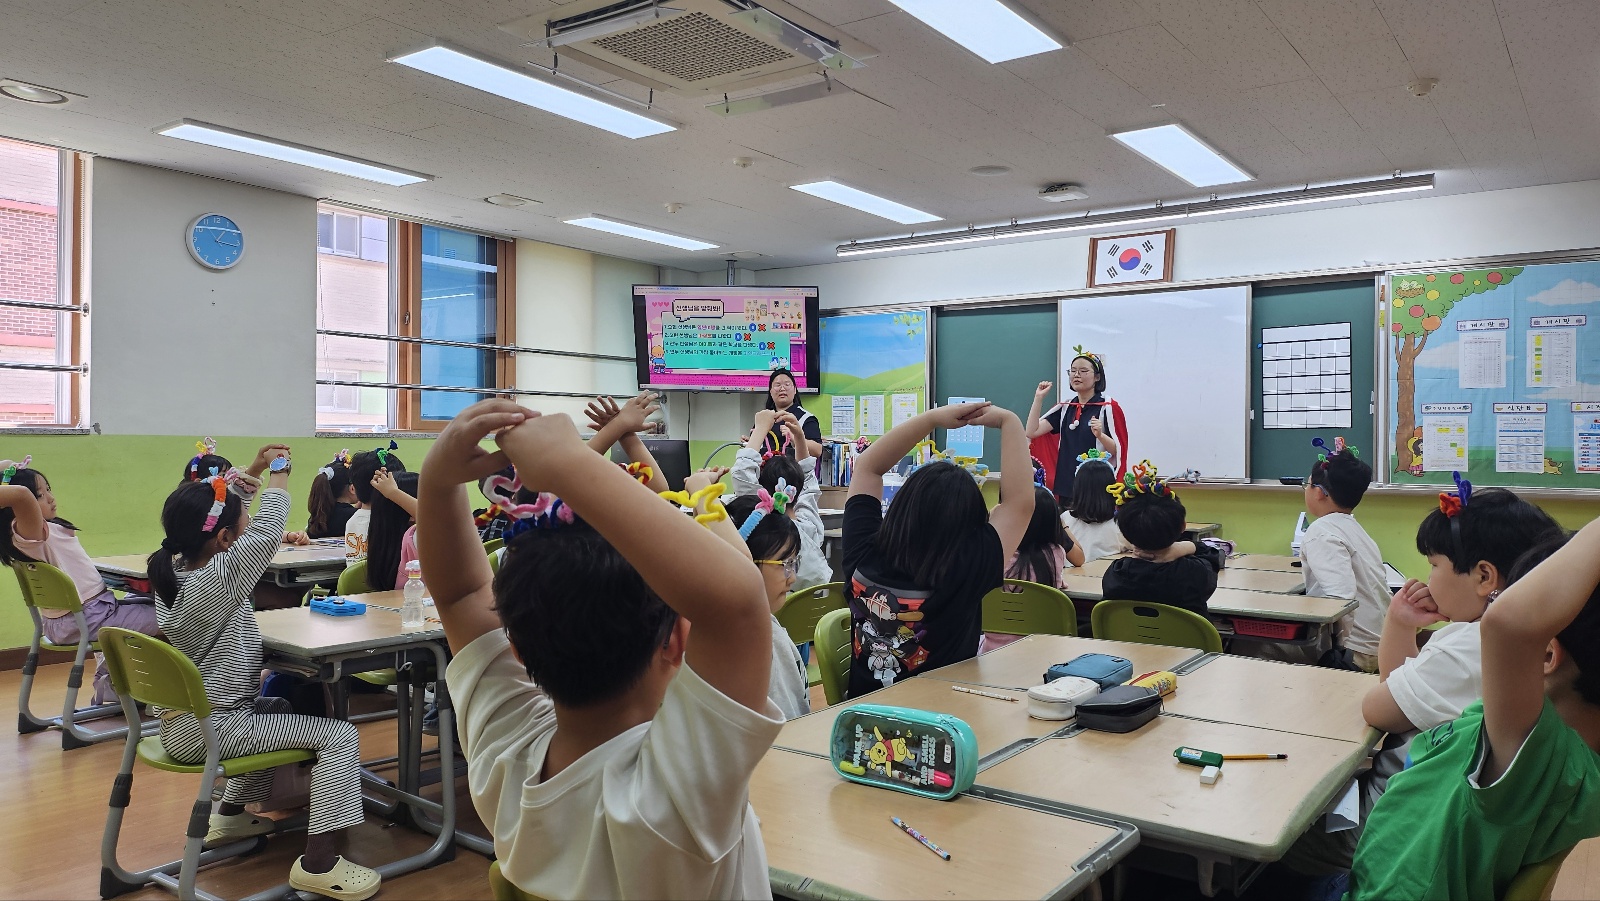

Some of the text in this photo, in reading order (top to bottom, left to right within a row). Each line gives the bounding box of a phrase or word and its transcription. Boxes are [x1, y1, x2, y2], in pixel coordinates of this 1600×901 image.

[853, 723, 864, 768] WAKE UP
[920, 734, 929, 785] AND SMELL
[928, 736, 936, 767] ROSES
